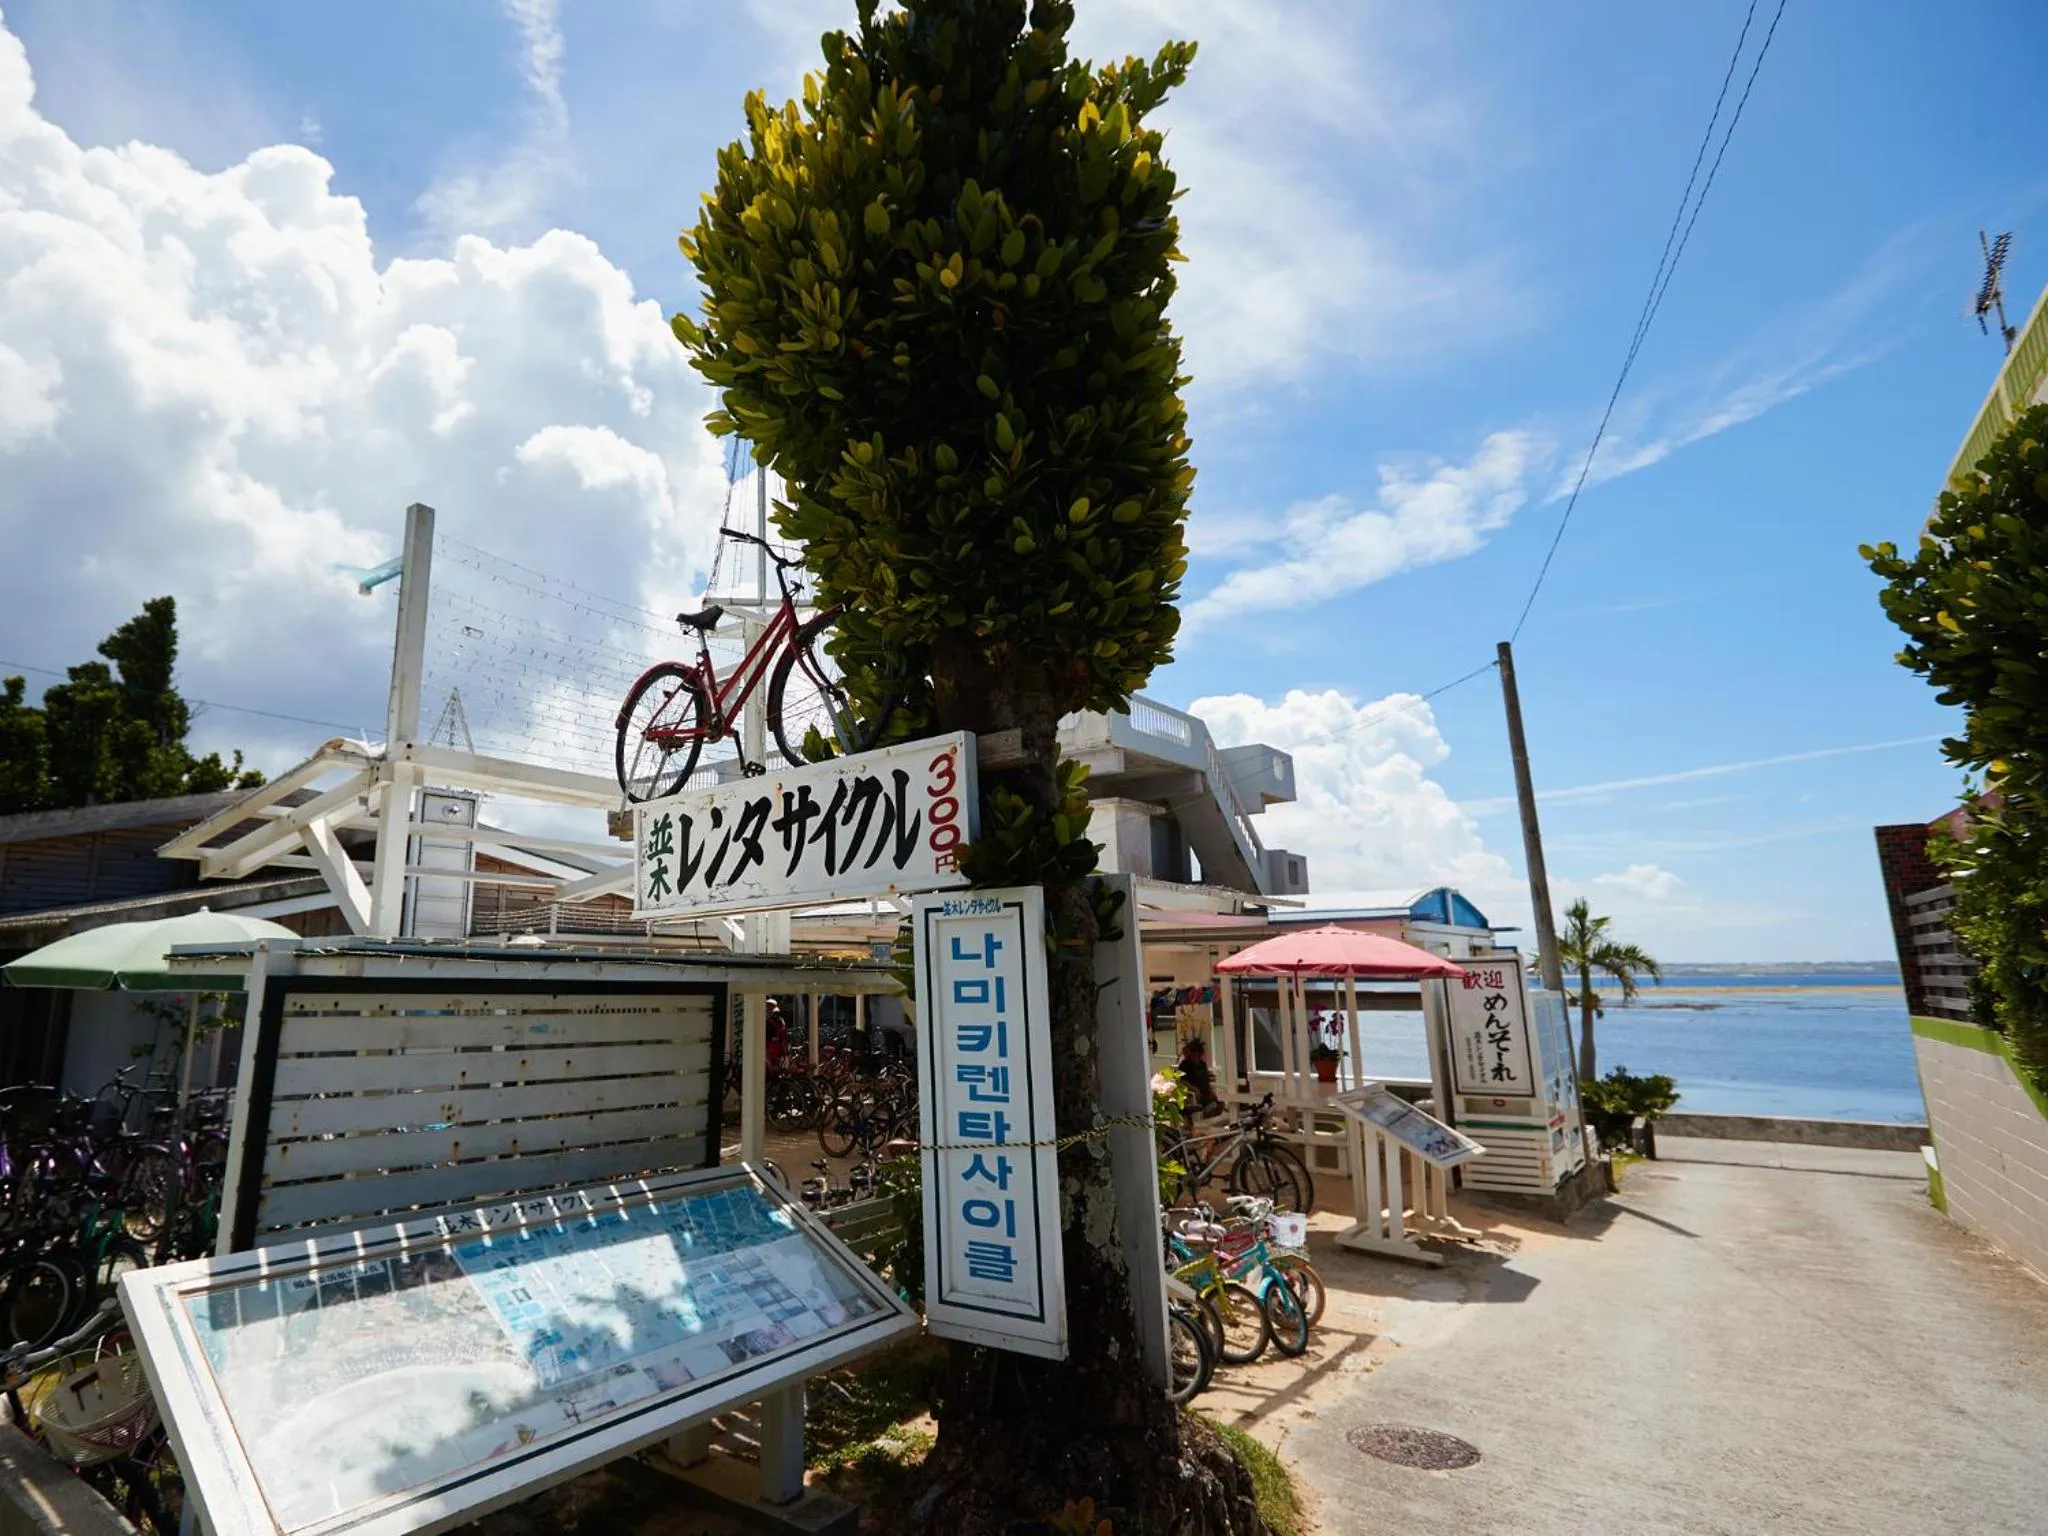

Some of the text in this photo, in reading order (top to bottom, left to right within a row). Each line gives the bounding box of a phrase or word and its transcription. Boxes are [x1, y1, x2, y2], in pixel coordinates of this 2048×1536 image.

[647, 769, 921, 902] 並木 レンタサイクル
[926, 752, 961, 875] 300円
[1463, 969, 1504, 990] 歓迎
[1482, 992, 1517, 1082] めんそーれ
[950, 931, 1018, 1283] 나미키렌타사이클
